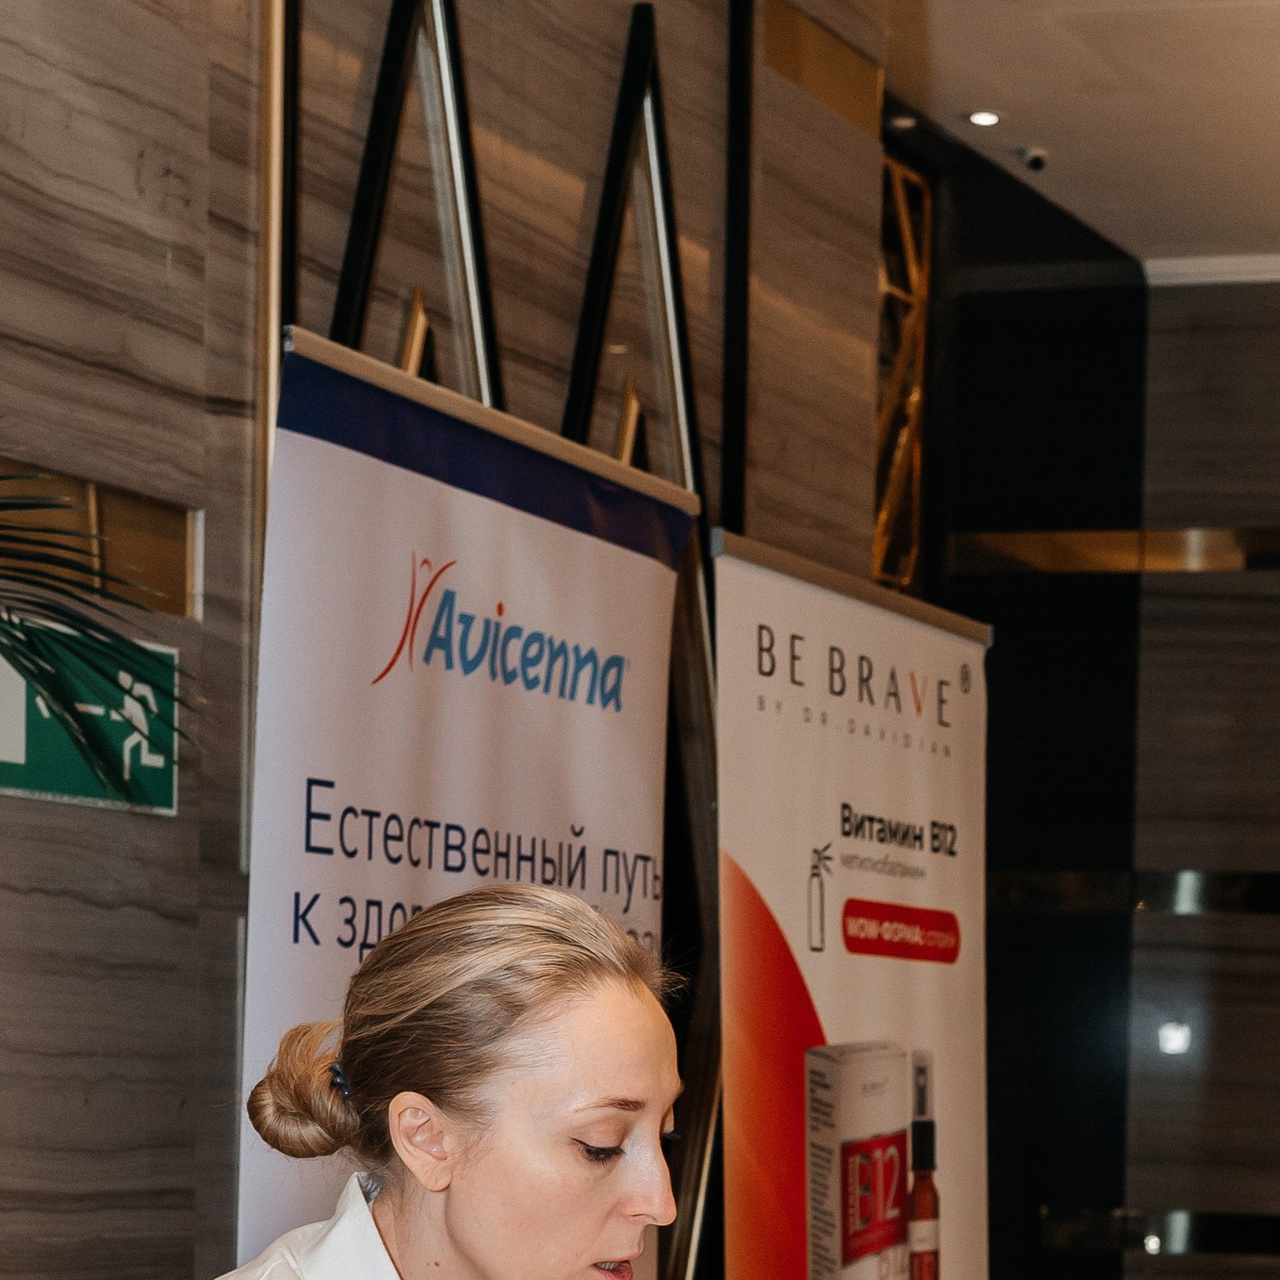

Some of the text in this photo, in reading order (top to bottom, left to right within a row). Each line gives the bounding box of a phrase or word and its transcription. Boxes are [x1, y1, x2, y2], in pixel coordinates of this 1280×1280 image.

[422, 588, 626, 712] Avicenna
[757, 623, 805, 687] BE
[304, 777, 587, 890] Естественный
[840, 801, 925, 850] Витамин
